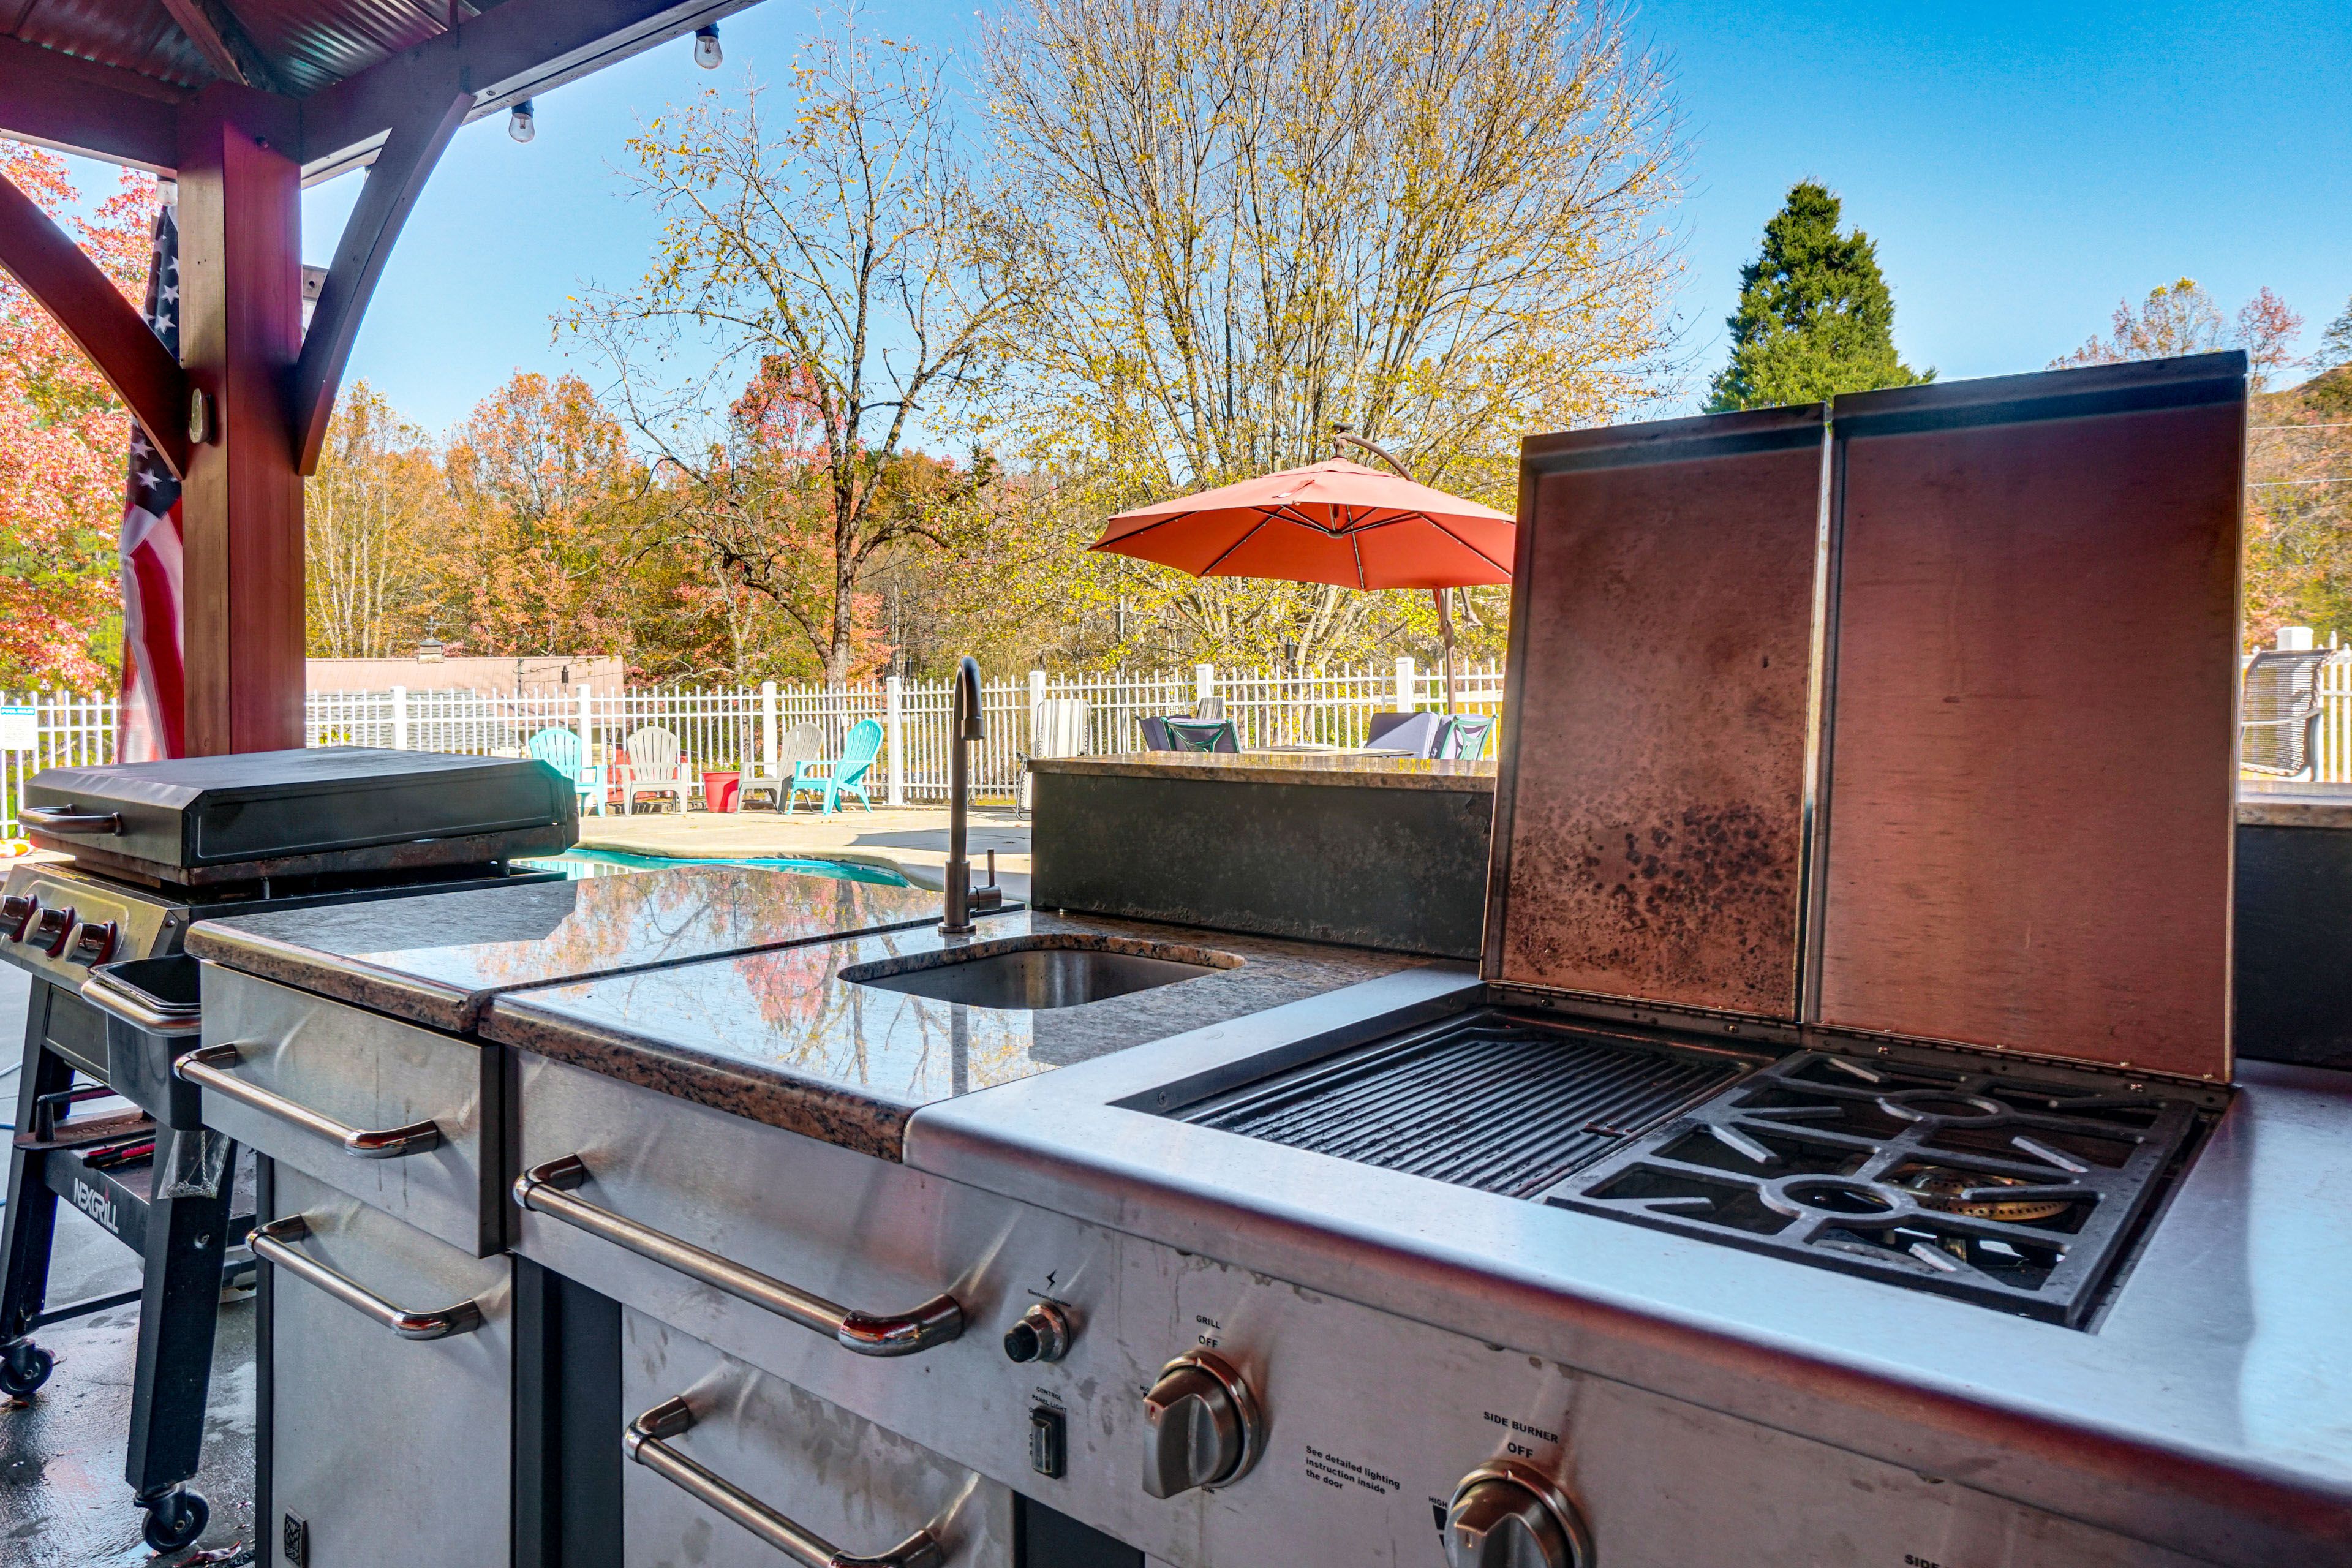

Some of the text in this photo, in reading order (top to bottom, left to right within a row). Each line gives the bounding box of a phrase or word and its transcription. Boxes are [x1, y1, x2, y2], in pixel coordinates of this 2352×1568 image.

[74, 1177, 119, 1234] NEXGRILL
[1196, 1315, 1221, 1329] GRILL
[1199, 1335, 1218, 1348] OFF
[1032, 1394, 1067, 1413] PANEL LIGHT
[1036, 1386, 1062, 1402] CONTROL
[1483, 1411, 1558, 1444] SIDE BURNER
[1507, 1442, 1534, 1458] OFF
[1306, 1445, 1400, 1490] See detailed lighting
[1306, 1457, 1385, 1494] instruction inside
[1306, 1469, 1343, 1489] the door
[1428, 1496, 1448, 1509] HIGH
